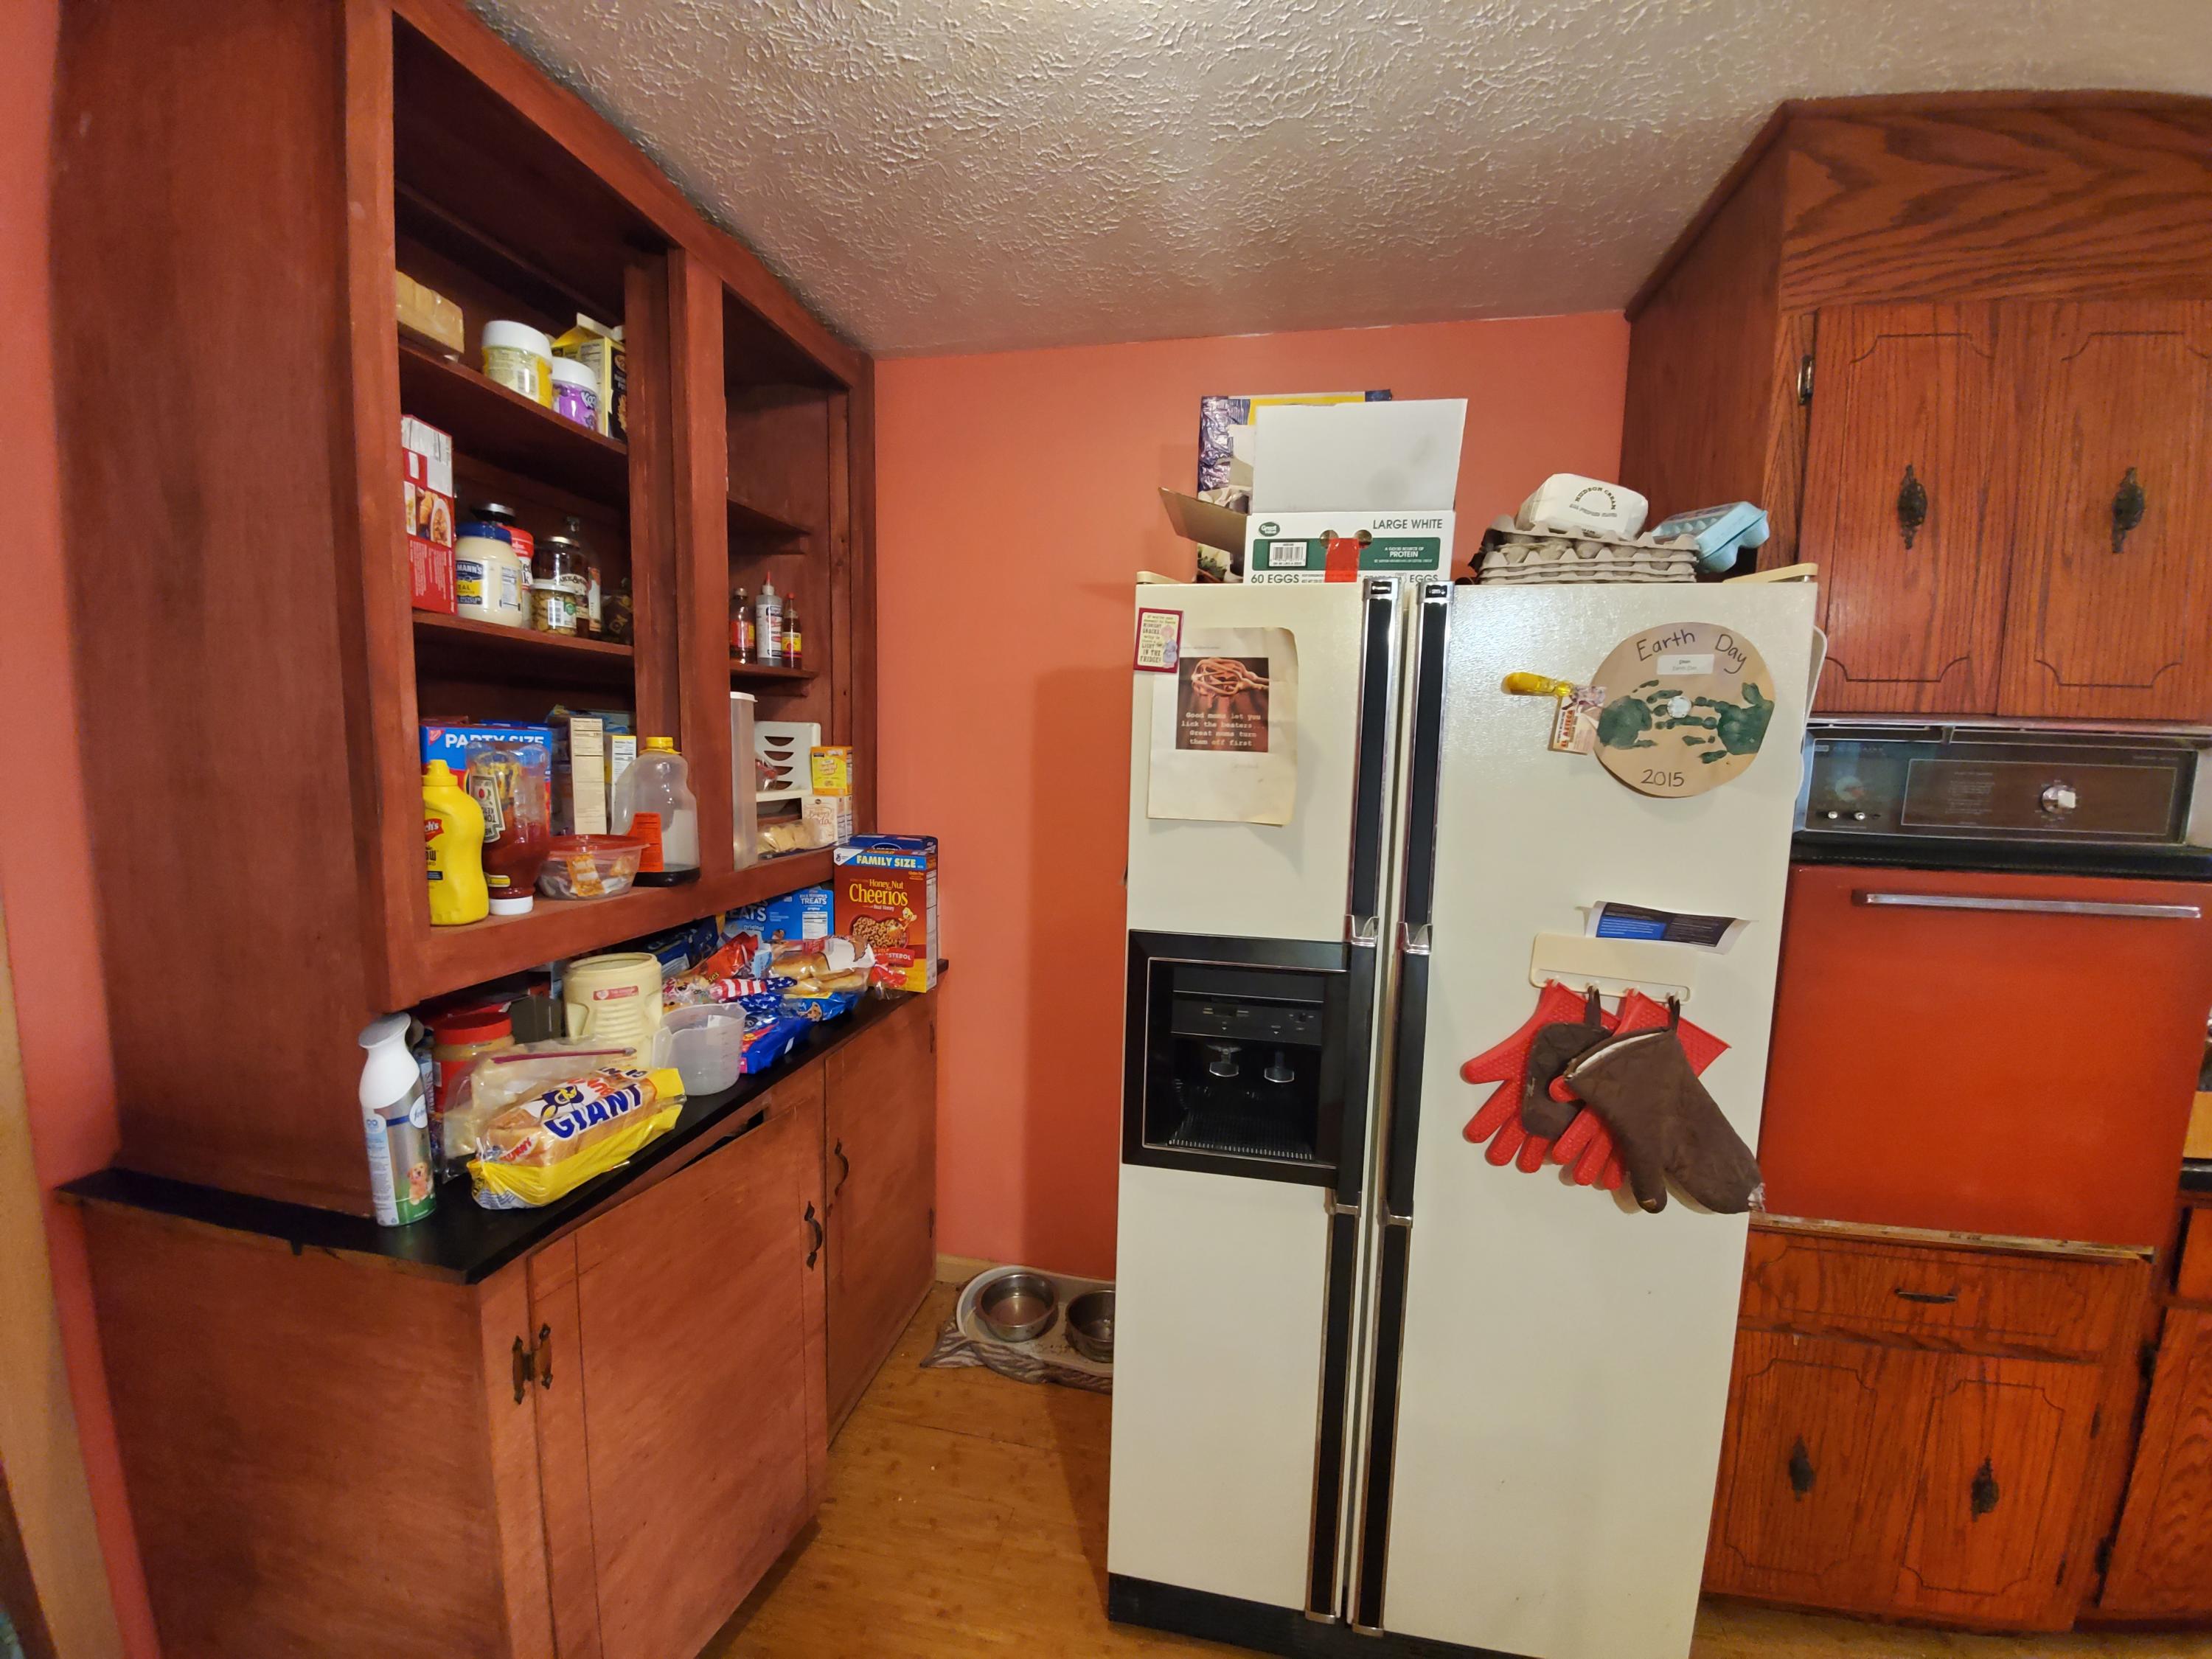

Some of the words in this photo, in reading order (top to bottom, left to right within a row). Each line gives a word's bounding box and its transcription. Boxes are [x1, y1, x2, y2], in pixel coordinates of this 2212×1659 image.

[1373, 519, 1408, 529] LARGE
[1411, 518, 1443, 529] WHITE
[457, 563, 483, 575] MANN'S
[1251, 574, 1265, 584] 60
[1267, 574, 1299, 584] EGGS
[1409, 574, 1439, 582] EGGS
[1636, 630, 1695, 661] Earth
[1715, 634, 1747, 674] Day
[1641, 769, 1685, 787] 2015
[857, 855, 894, 867] FAMILY
[894, 858, 917, 869] SIZE
[869, 879, 889, 890] Honey
[891, 880, 904, 889] Nut
[849, 883, 908, 906] Cheerios
[801, 897, 827, 905] TREATS
[729, 906, 767, 922] EATS
[875, 952, 911, 961] STEROL
[544, 1083, 641, 1138] GIANT
